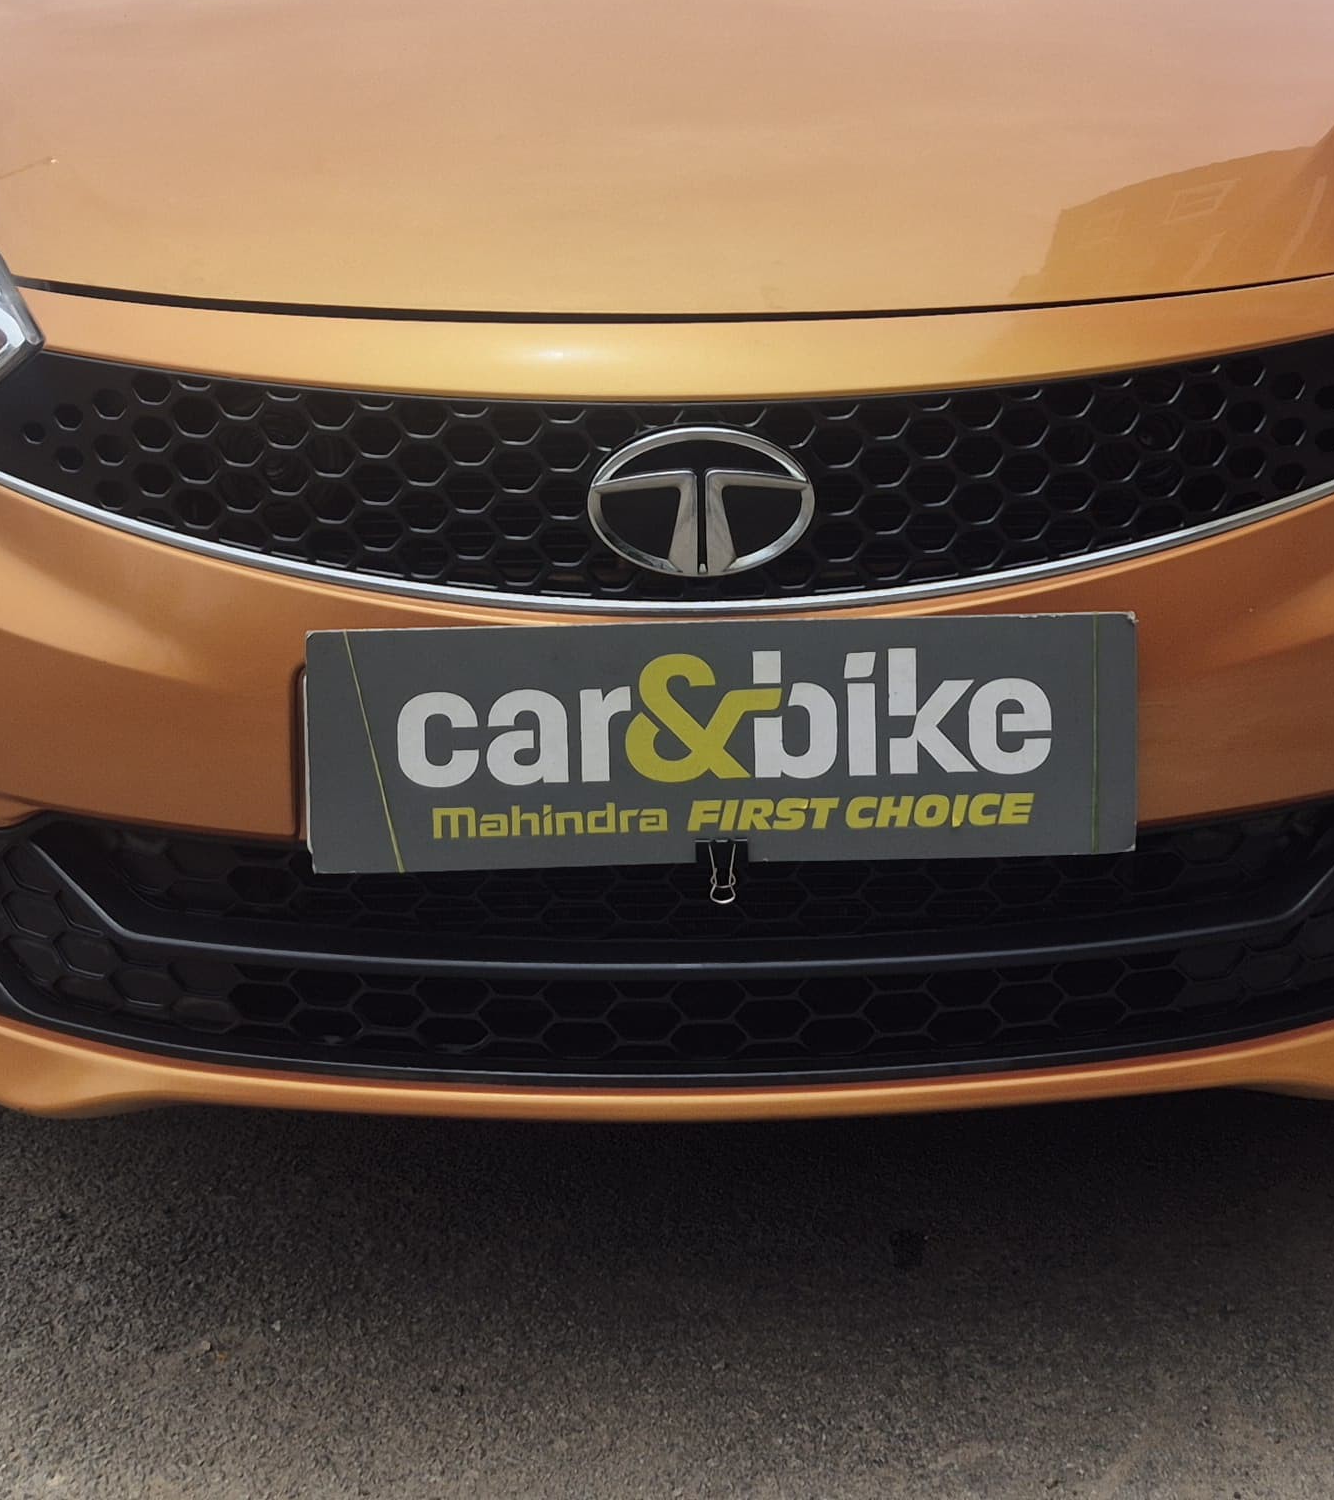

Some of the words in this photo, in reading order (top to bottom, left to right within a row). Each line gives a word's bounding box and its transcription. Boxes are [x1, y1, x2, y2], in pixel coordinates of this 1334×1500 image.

[397, 647, 1052, 788] car&bike
[432, 802, 669, 840] Mahindra
[687, 797, 840, 832] FIRST
[845, 793, 1035, 828] CHOICE
